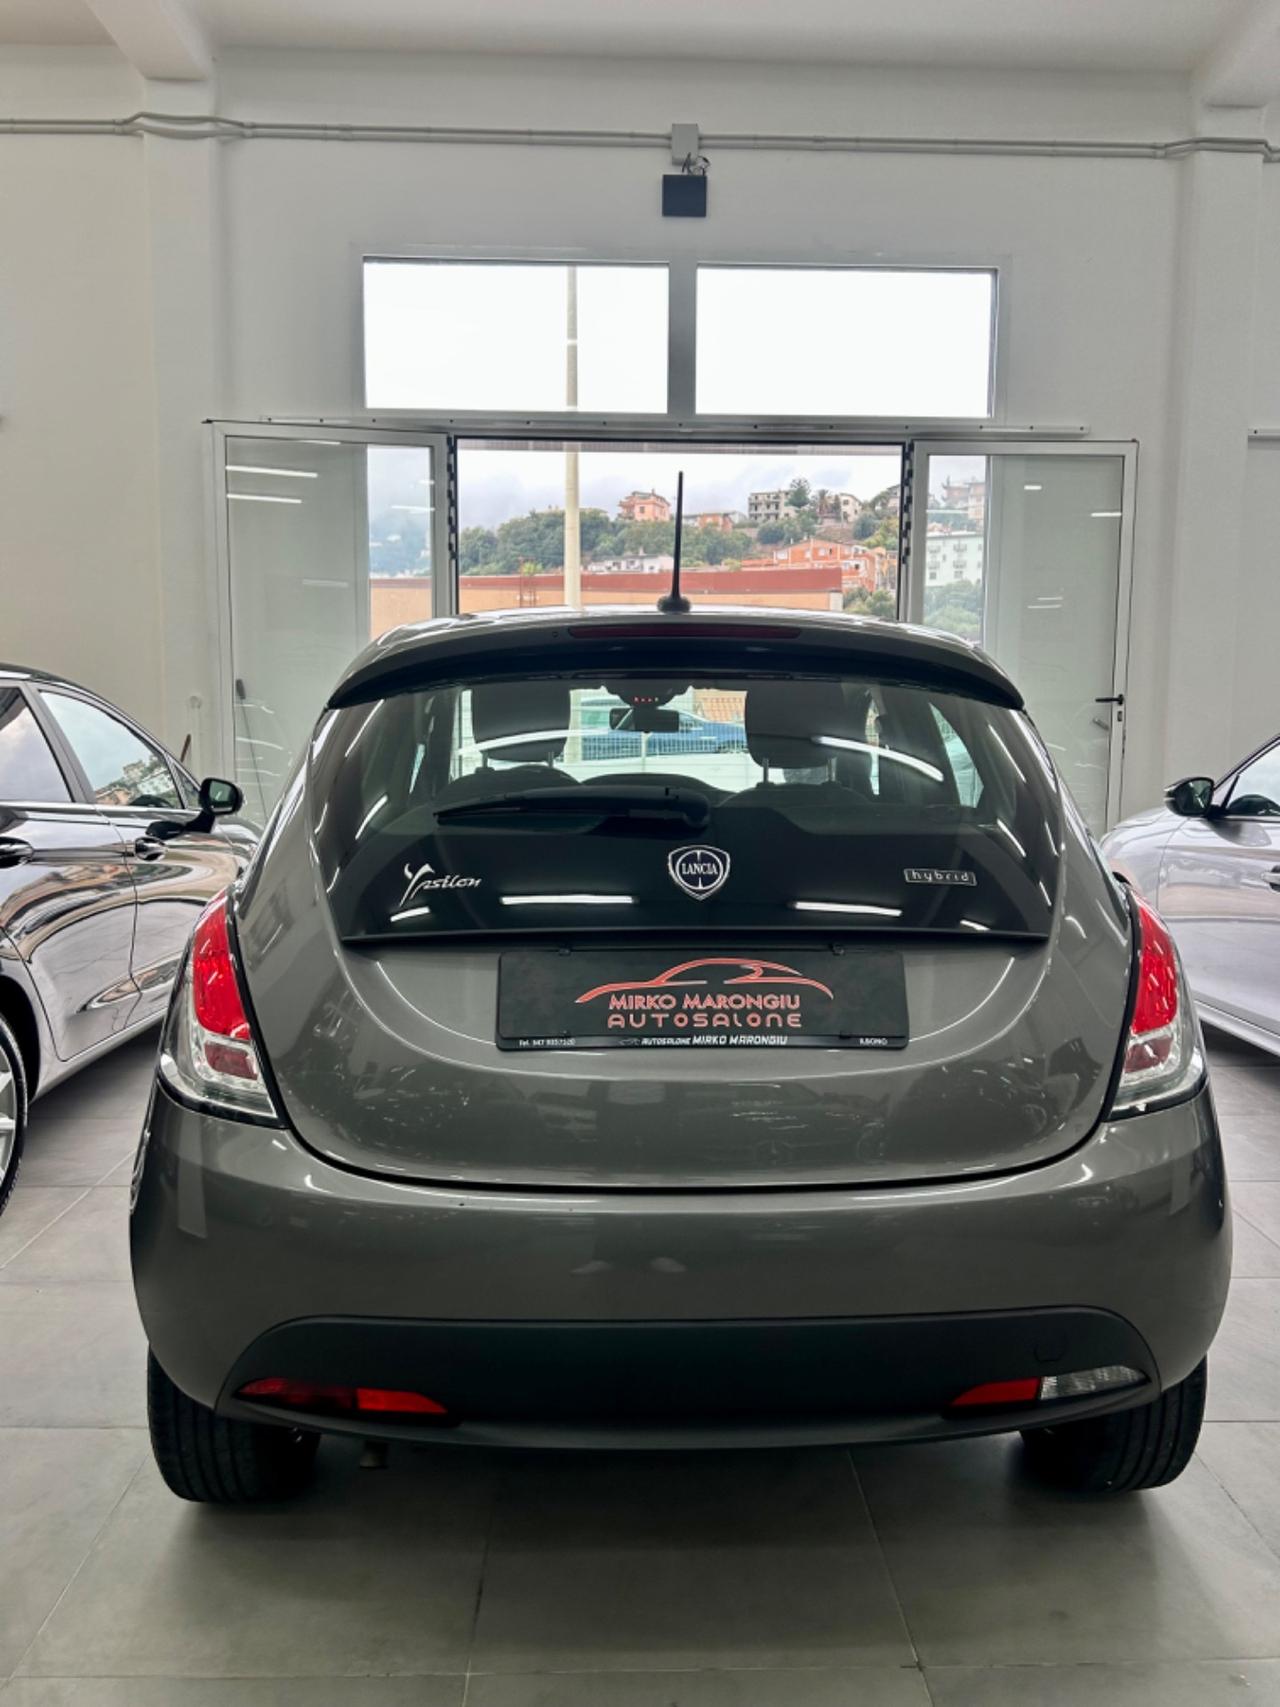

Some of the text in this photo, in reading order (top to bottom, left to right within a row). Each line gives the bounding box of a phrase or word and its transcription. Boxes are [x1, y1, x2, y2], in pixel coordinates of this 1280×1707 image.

[681, 863, 718, 875] LANCIA
[911, 869, 969, 883] hybrid
[400, 863, 482, 907] Ypsilon
[609, 994, 800, 1010] MIRKO MARONGIU
[607, 1013, 802, 1028] AUTOSALONE
[641, 1035, 788, 1046] AUTOSALONE MIRKO MARONGIU
